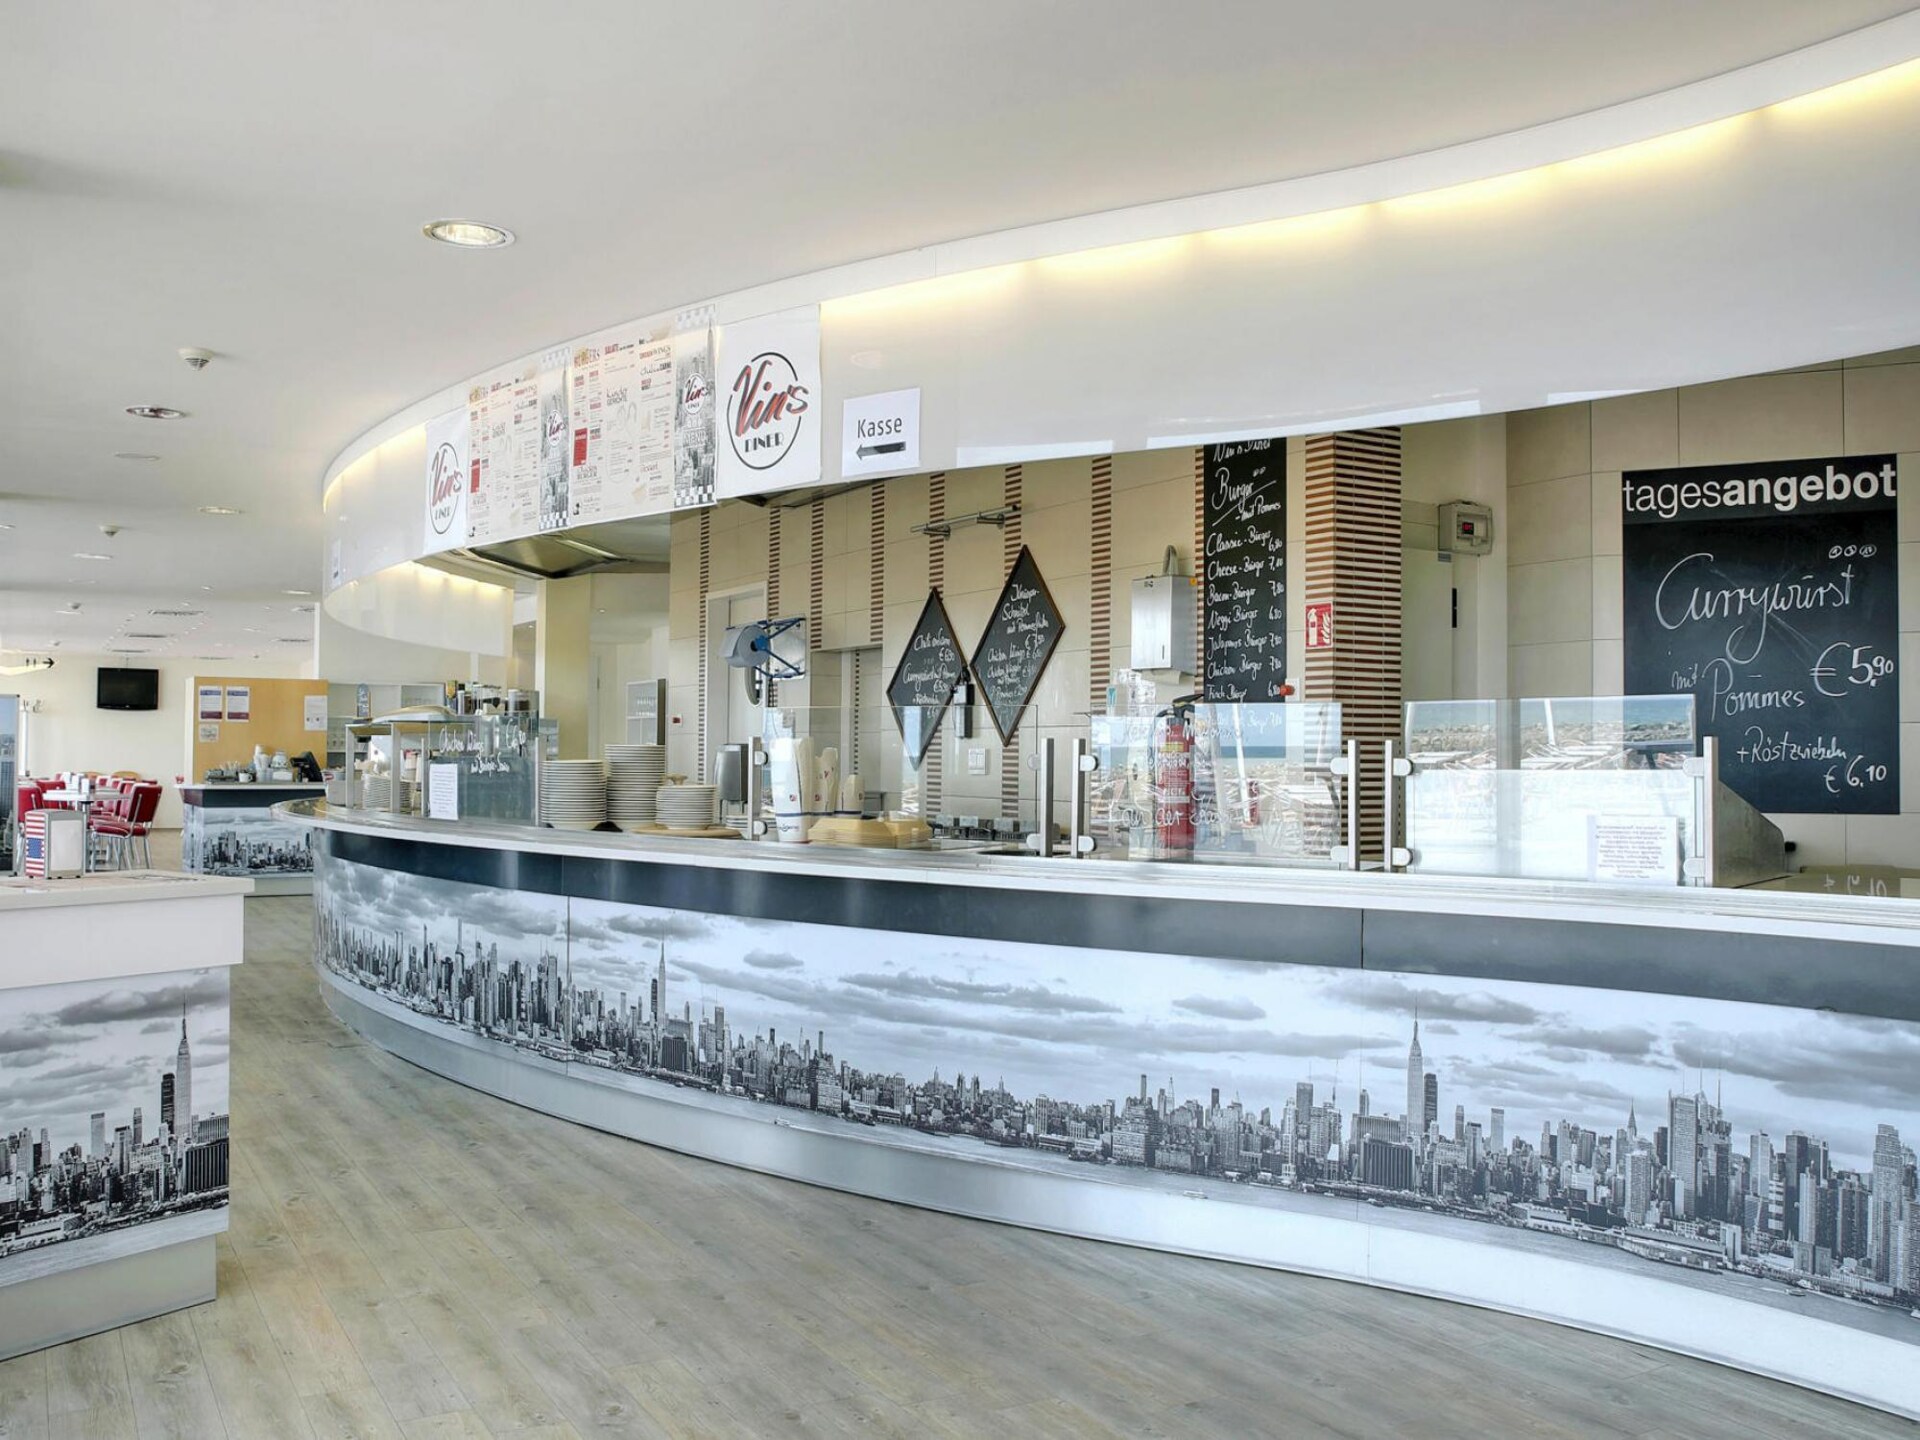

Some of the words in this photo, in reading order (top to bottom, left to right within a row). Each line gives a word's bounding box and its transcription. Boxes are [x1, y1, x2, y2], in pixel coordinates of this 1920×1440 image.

[733, 360, 809, 437] Vin's
[745, 432, 785, 452] DINER
[857, 417, 902, 439] Kasse
[431, 448, 463, 507] Vin's
[1623, 464, 1897, 518] tagesangebot
[1671, 663, 1699, 691] mit
[1701, 657, 1806, 723] Pommes
